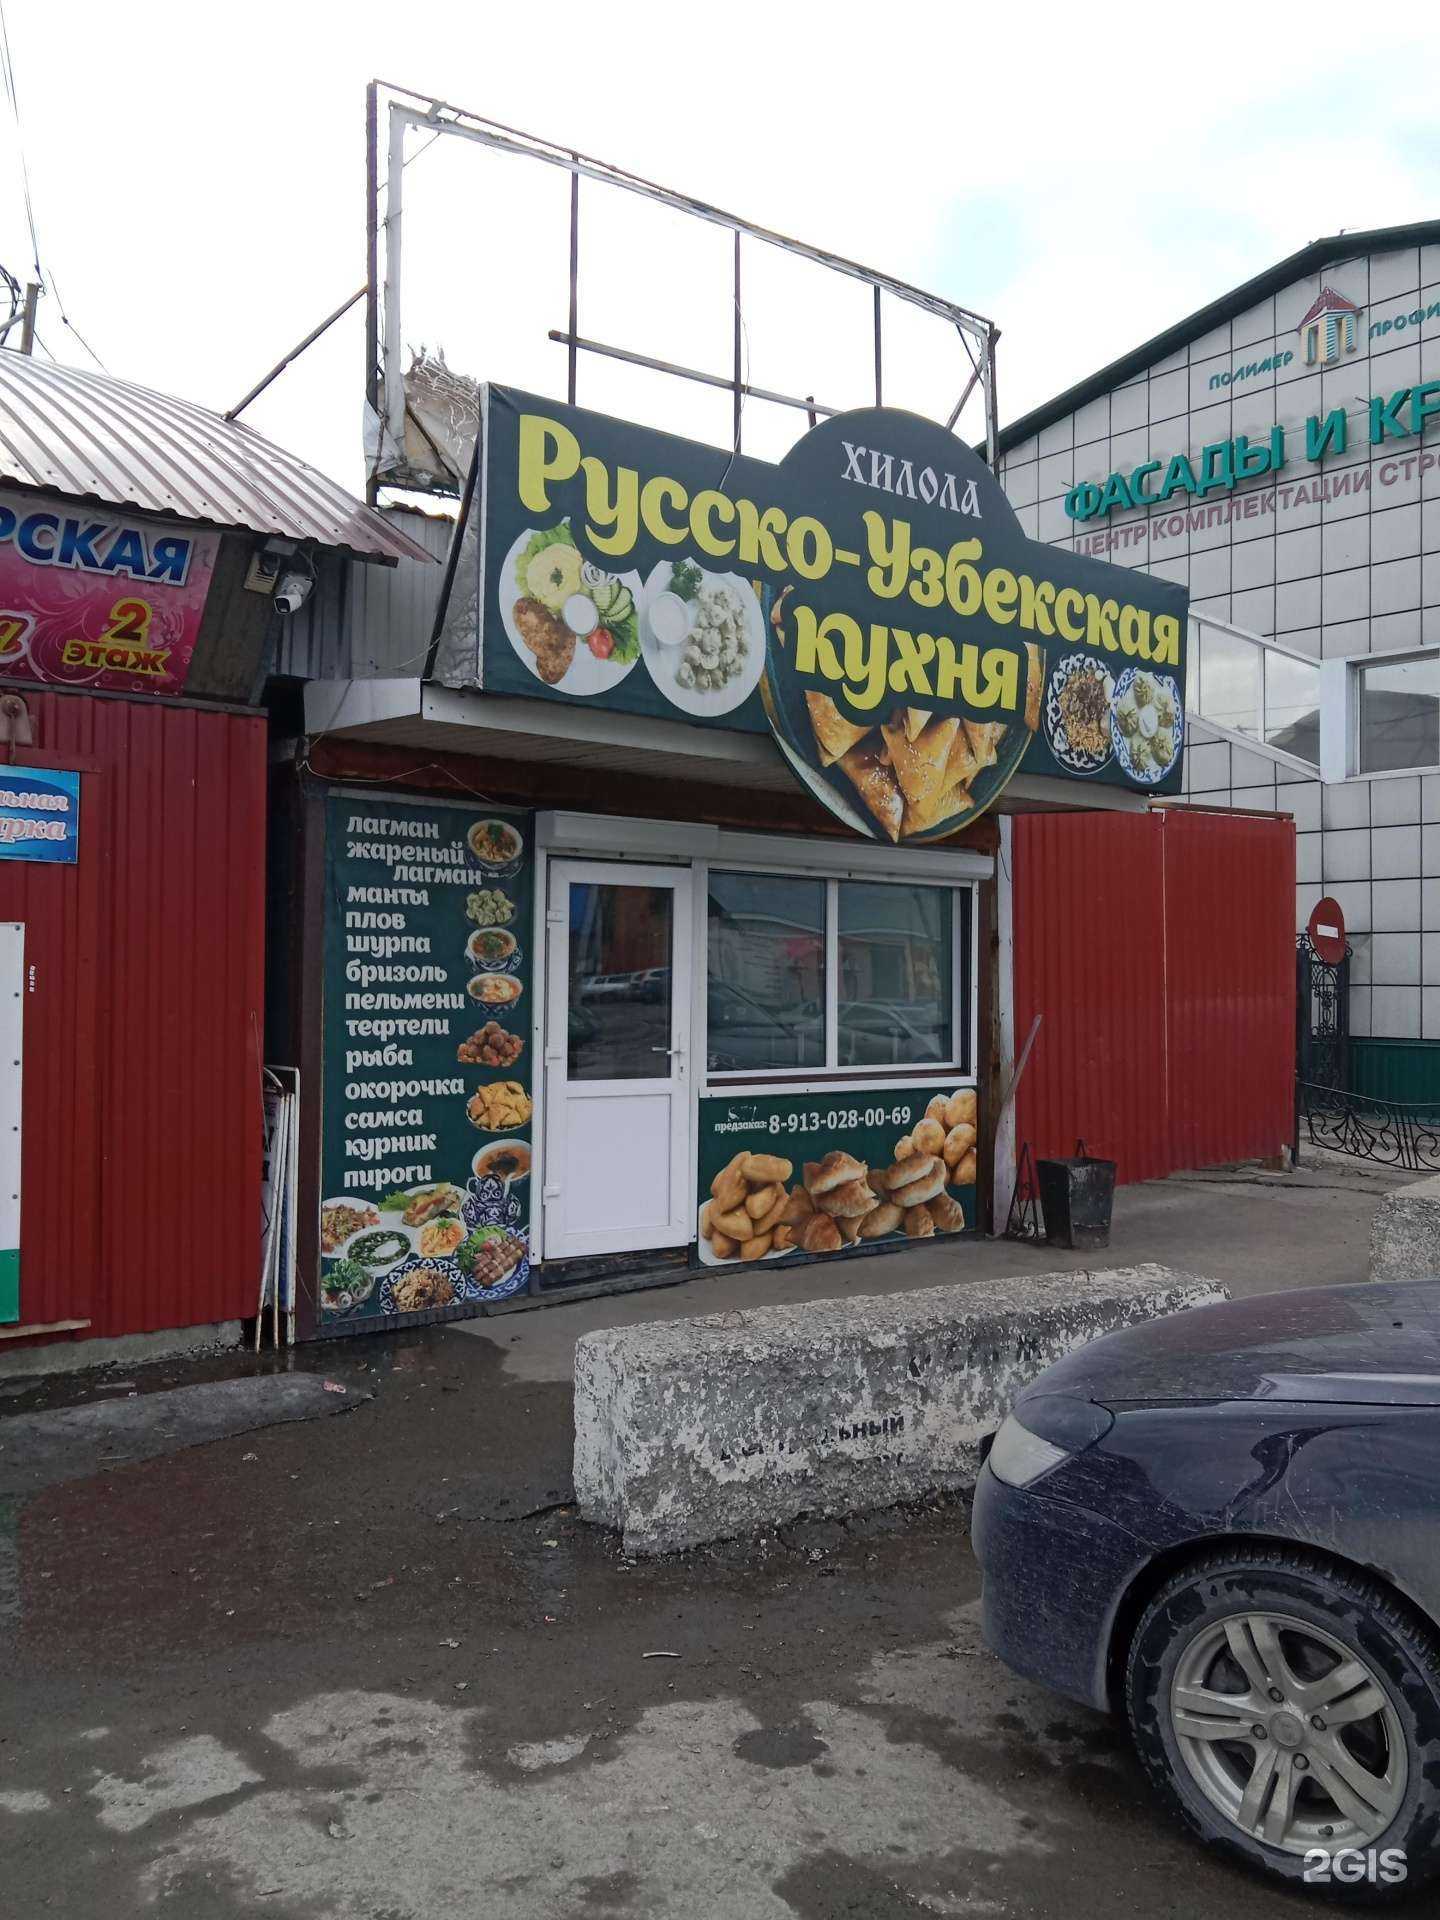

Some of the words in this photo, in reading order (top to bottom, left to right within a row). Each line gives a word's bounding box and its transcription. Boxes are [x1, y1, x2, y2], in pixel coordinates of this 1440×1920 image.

[1209, 350, 1294, 390] ПОЛИМЕР
[1369, 302, 1440, 339] ПРОФИ
[1064, 425, 1285, 522] ФАСАДЫ
[1306, 407, 1347, 463] И
[841, 441, 983, 518] ХИЛОЛА
[1075, 524, 1148, 556] ЦЕНТР
[1152, 468, 1371, 541] КОМПЛЕКТАЦИИ
[1379, 453, 1440, 486] СТР
[108, 600, 150, 643] 2
[64, 642, 170, 674] этаж
[346, 816, 440, 839] лагман
[346, 841, 466, 865] жареный
[392, 864, 482, 885] лагман
[346, 886, 430, 906] манты
[345, 911, 406, 930] плов
[346, 934, 431, 958] шурпа
[345, 958, 448, 988] бризоль
[345, 993, 465, 1010] пельмени
[345, 1018, 450, 1042] тефтели
[345, 1043, 413, 1073] рыба
[345, 1078, 465, 1103] окорочка
[344, 1108, 423, 1129] самса
[714, 1120, 767, 1134] предзаказ:
[768, 1105, 912, 1135] 8-913-028-00-69
[344, 1133, 438, 1161] курник
[343, 1164, 433, 1191] пироги
